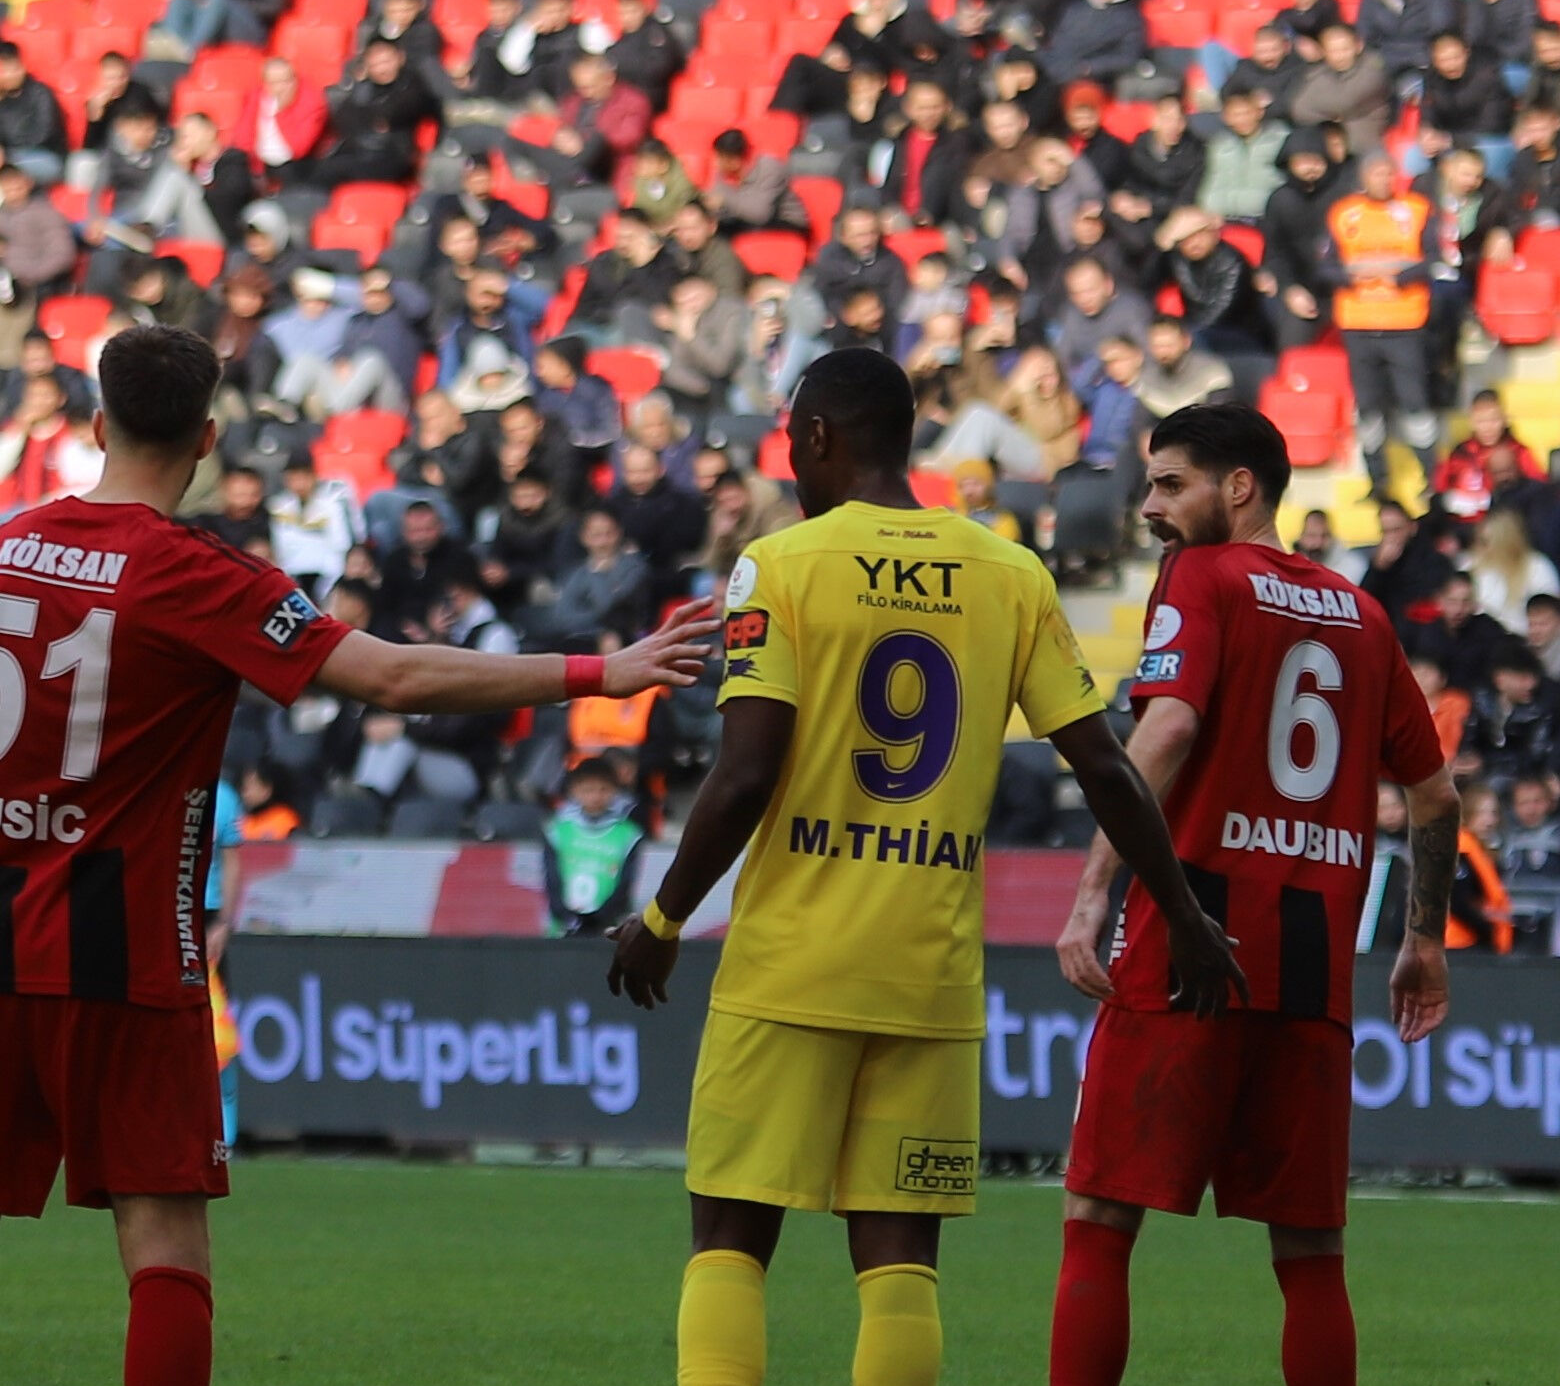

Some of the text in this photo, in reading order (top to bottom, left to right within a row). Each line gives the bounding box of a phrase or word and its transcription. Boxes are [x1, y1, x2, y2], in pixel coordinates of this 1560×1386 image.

[853, 554, 964, 598] YKT
[1247, 571, 1362, 622] KÖKSAN
[890, 595, 964, 616] KİRALAMA
[850, 629, 963, 805] 9
[1268, 638, 1343, 803] 6
[1220, 812, 1363, 870] DAUBIN
